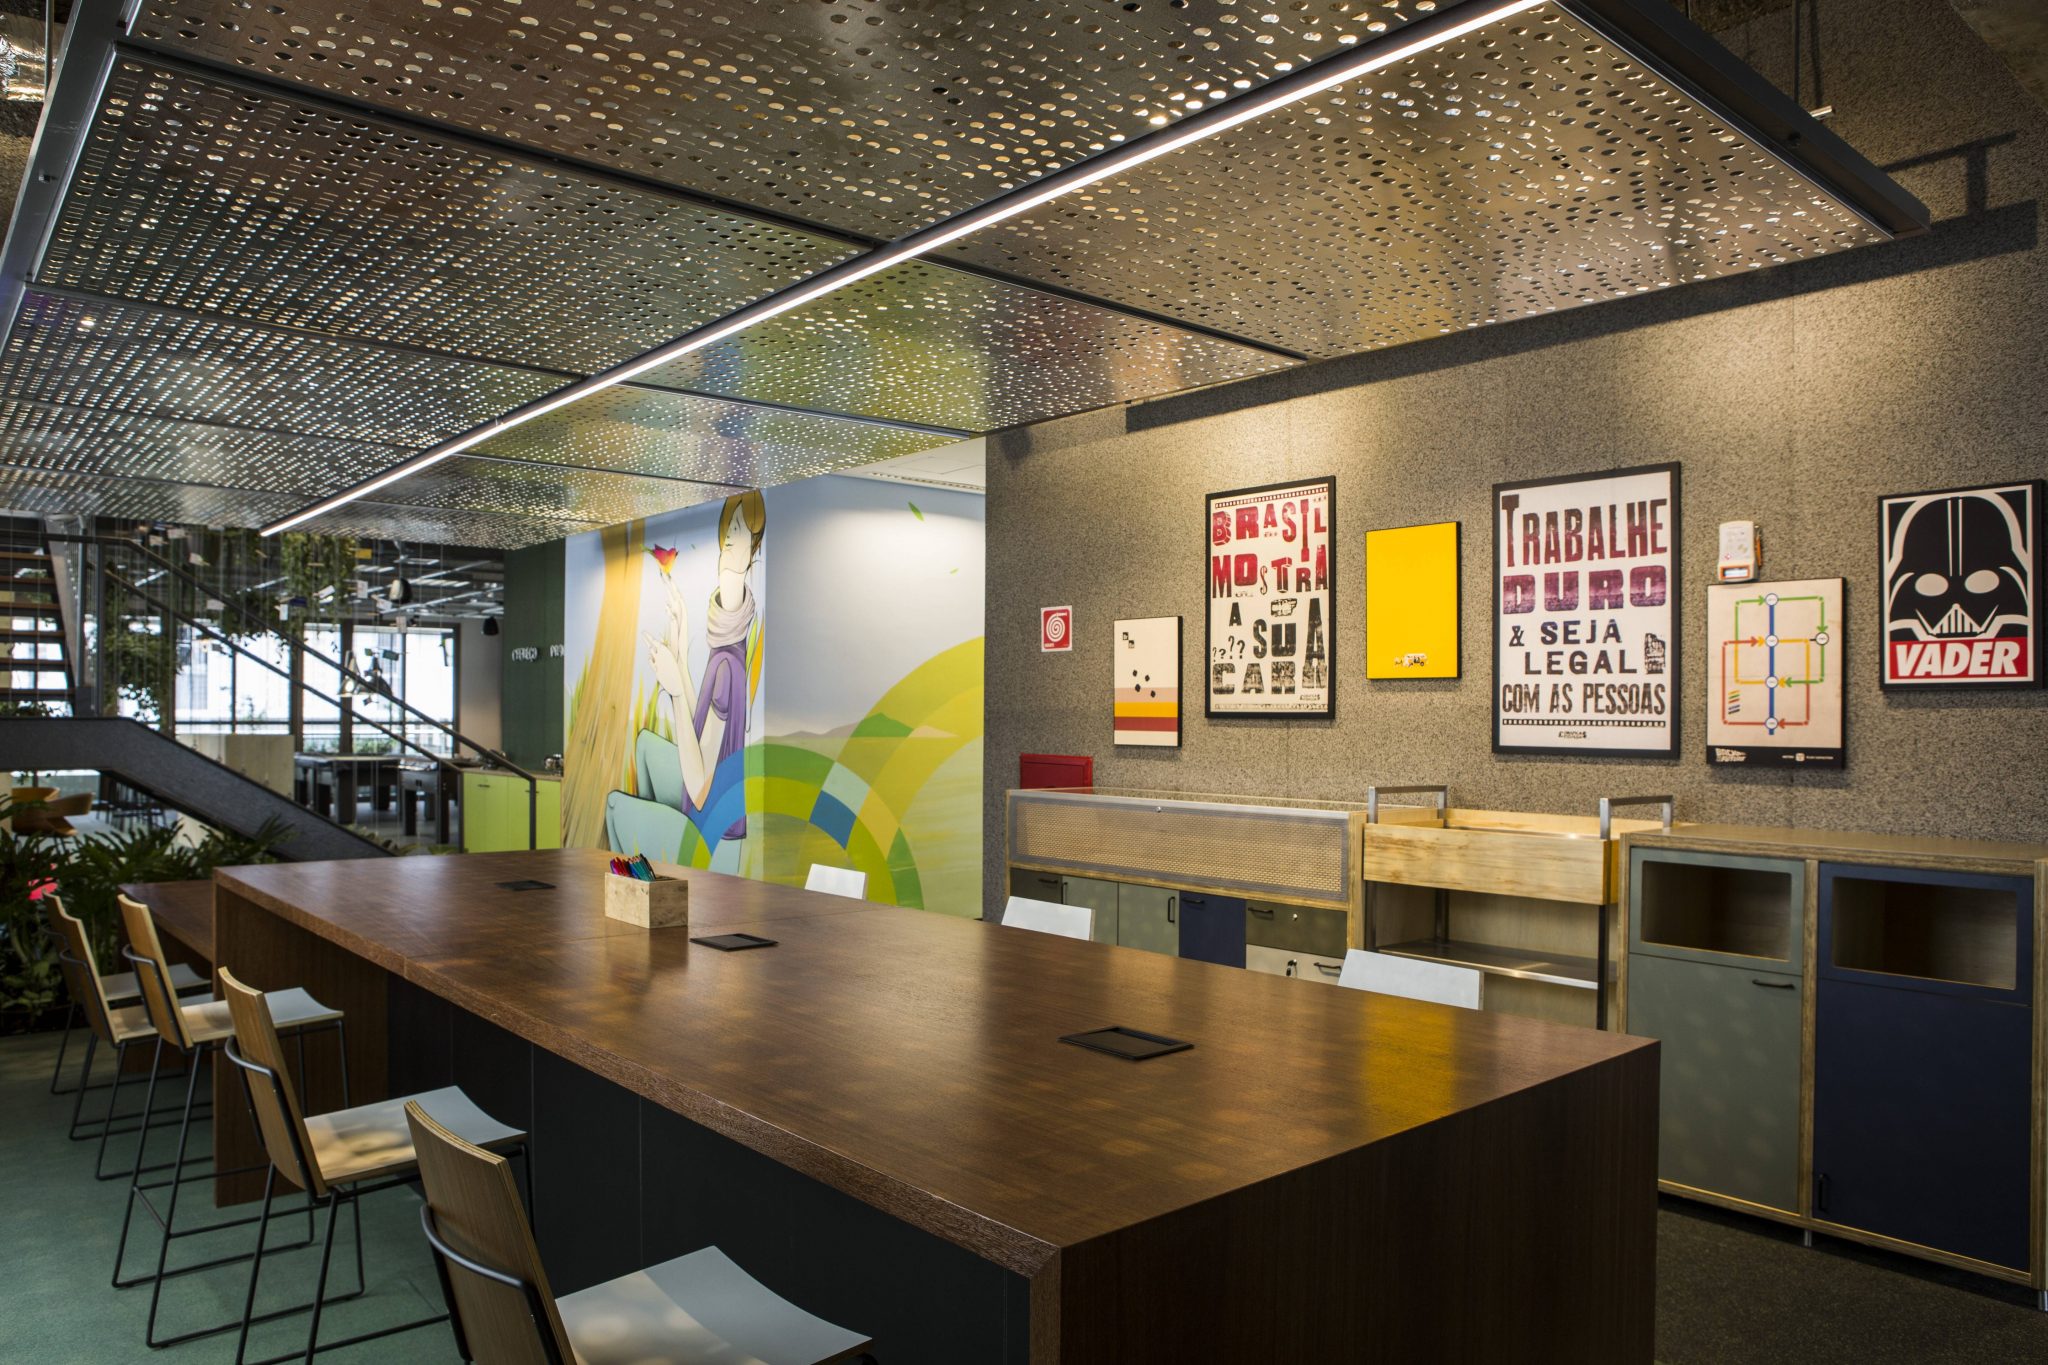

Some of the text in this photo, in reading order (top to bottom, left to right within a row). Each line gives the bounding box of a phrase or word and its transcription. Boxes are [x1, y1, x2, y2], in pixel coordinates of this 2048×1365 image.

[1212, 499, 1327, 562] BRASIL
[1502, 494, 1667, 567] TRABALHE
[1212, 544, 1328, 599] MOSTRA
[1503, 565, 1667, 614] DURO
[1509, 619, 1622, 647] & SEJA
[1525, 649, 1637, 675] LEGAL
[1895, 640, 2020, 676] VADER
[1212, 661, 1327, 694] CARA
[1502, 683, 1666, 715] COM AS PESSOAS
